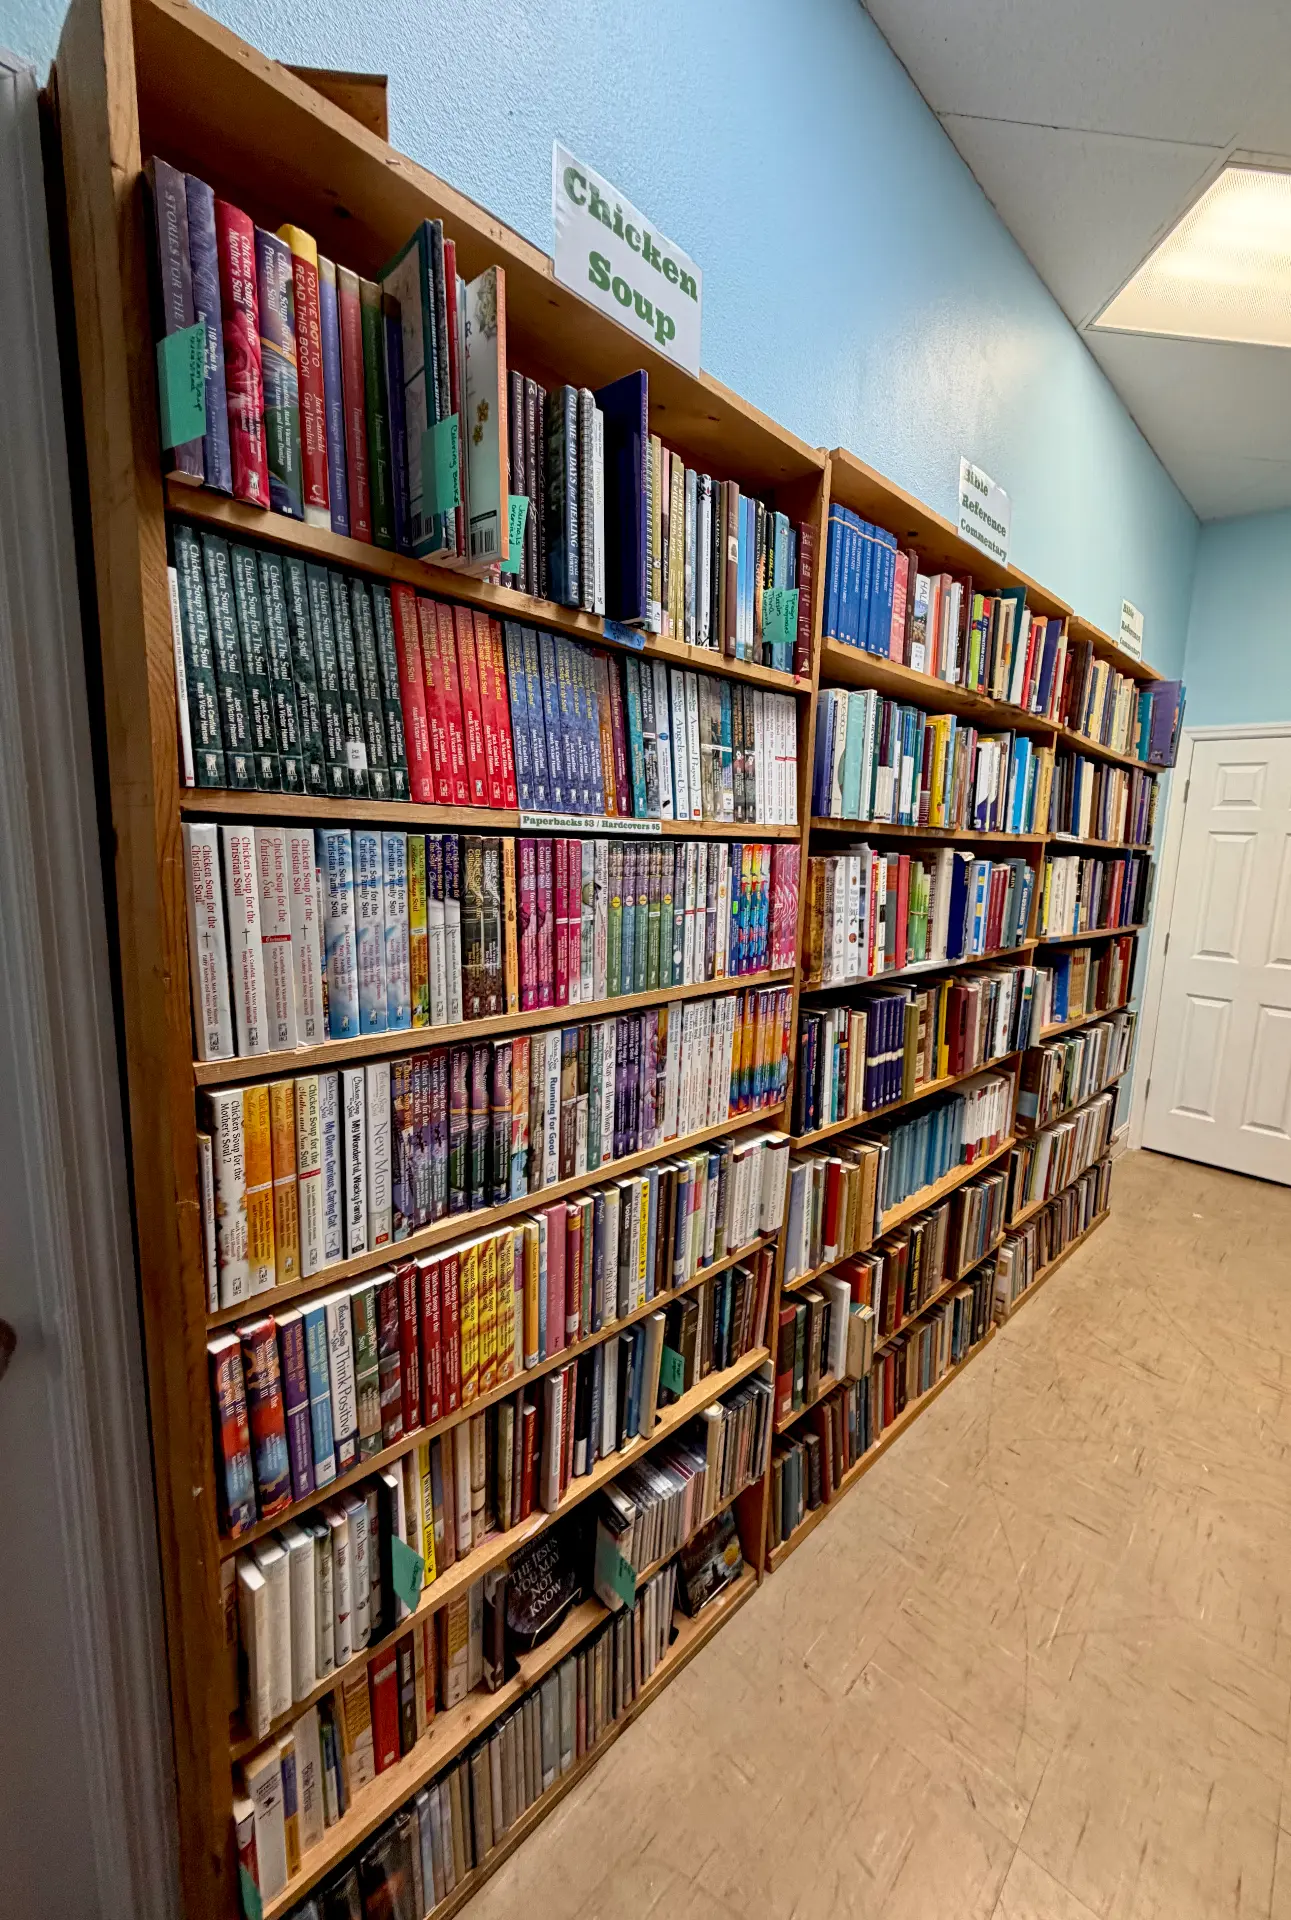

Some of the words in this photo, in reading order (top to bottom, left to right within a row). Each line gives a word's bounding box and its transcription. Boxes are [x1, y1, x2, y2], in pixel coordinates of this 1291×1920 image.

[165, 191, 181, 255] STORIES
[563, 166, 697, 303] Chicken
[228, 228, 241, 275] Mother's
[241, 236, 252, 276] Chicken
[170, 260, 183, 289] FOR
[264, 245, 276, 284] Preteen
[277, 252, 288, 292] Chicken
[232, 278, 243, 303] Soul
[296, 264, 306, 300] READ
[243, 282, 254, 307] Soup
[267, 287, 277, 311] Soul
[307, 271, 318, 321] YOU'VE
[588, 251, 676, 346] Soup
[172, 293, 185, 321] THE
[246, 310, 255, 326] for
[278, 295, 289, 321] Soup
[298, 304, 307, 333] THIS
[208, 327, 216, 339] 110
[247, 328, 256, 345] the
[281, 324, 290, 339] for
[310, 321, 319, 349] GOT
[209, 341, 217, 363] Stories
[282, 341, 291, 356] the
[300, 337, 309, 377] BOOK!
[311, 352, 320, 367] TO
[303, 392, 313, 409] Gay
[314, 395, 323, 413] Jack
[306, 411, 314, 455] Hendricks
[316, 416, 325, 453] Canfield
[569, 424, 577, 440] ME
[569, 442, 577, 454] 40
[965, 468, 988, 497] Bible
[570, 502, 578, 548] HEALING
[962, 493, 1006, 537] Reference
[961, 519, 1007, 562] Commentary
[190, 544, 202, 582] Chicken
[193, 584, 205, 608] Soup
[196, 610, 207, 627] For
[420, 607, 429, 632] Chicken
[1123, 603, 1134, 619] Bible
[198, 628, 209, 647] The
[422, 633, 431, 649] Soup
[1121, 620, 1140, 642] Reference
[200, 649, 211, 668] Soul
[424, 651, 432, 660] for
[1120, 637, 1140, 658] Commentary
[197, 682, 205, 699] Mark
[426, 672, 434, 686] Soul
[199, 700, 207, 721] Victor
[206, 694, 215, 712] Jack
[201, 722, 209, 744] Hansen
[208, 714, 217, 736] Canfield
[676, 718, 684, 752] Angels
[678, 779, 684, 793] Us
[523, 816, 582, 826] Paperbacks
[602, 821, 650, 830] Hardcovers
[202, 845, 214, 877] Chicken
[328, 836, 337, 871] Christian
[336, 836, 346, 866] Chicken
[192, 845, 203, 882] Christian
[204, 879, 215, 900] Soup
[328, 873, 338, 899] Family
[338, 868, 347, 888] Soup
[340, 889, 348, 903] for
[207, 902, 216, 915] for
[331, 901, 339, 918] Soul
[208, 917, 217, 928] the
[547, 1077, 557, 1115] Running
[220, 1103, 230, 1137] Mother's
[231, 1100, 240, 1132] Chicken
[324, 1121, 335, 1134] My
[351, 1119, 360, 1133] My
[549, 1118, 557, 1130] for
[222, 1139, 231, 1157] Soul
[231, 1134, 241, 1153] Soup
[374, 1121, 388, 1156] New
[233, 1155, 241, 1169] for
[352, 1135, 361, 1175] Wonderful,
[234, 1170, 242, 1181] the
[326, 1161, 335, 1190] Curious,
[375, 1158, 389, 1206] Moms
[351, 1175, 361, 1201] Wacky
[326, 1190, 335, 1215] Caring
[352, 1201, 363, 1225] Family
[327, 1215, 336, 1229] Cat
[605, 1268, 613, 1304] PRAYER
[221, 1357, 232, 1390] Teenage
[231, 1355, 240, 1382] Chicken
[336, 1346, 352, 1389] Think
[224, 1389, 234, 1405] Soul
[232, 1383, 242, 1401] Soup
[226, 1406, 234, 1416] III
[236, 1401, 244, 1413] for
[338, 1386, 353, 1436] Positive
[237, 1414, 245, 1426] the
[356, 1519, 365, 1539] BIG
[510, 1560, 532, 1585] THE
[532, 1536, 558, 1567] JESUS
[515, 1571, 537, 1596] YOU
[538, 1552, 559, 1574] MAY
[531, 1571, 553, 1600] NOT
[529, 1579, 562, 1617] KNOW
